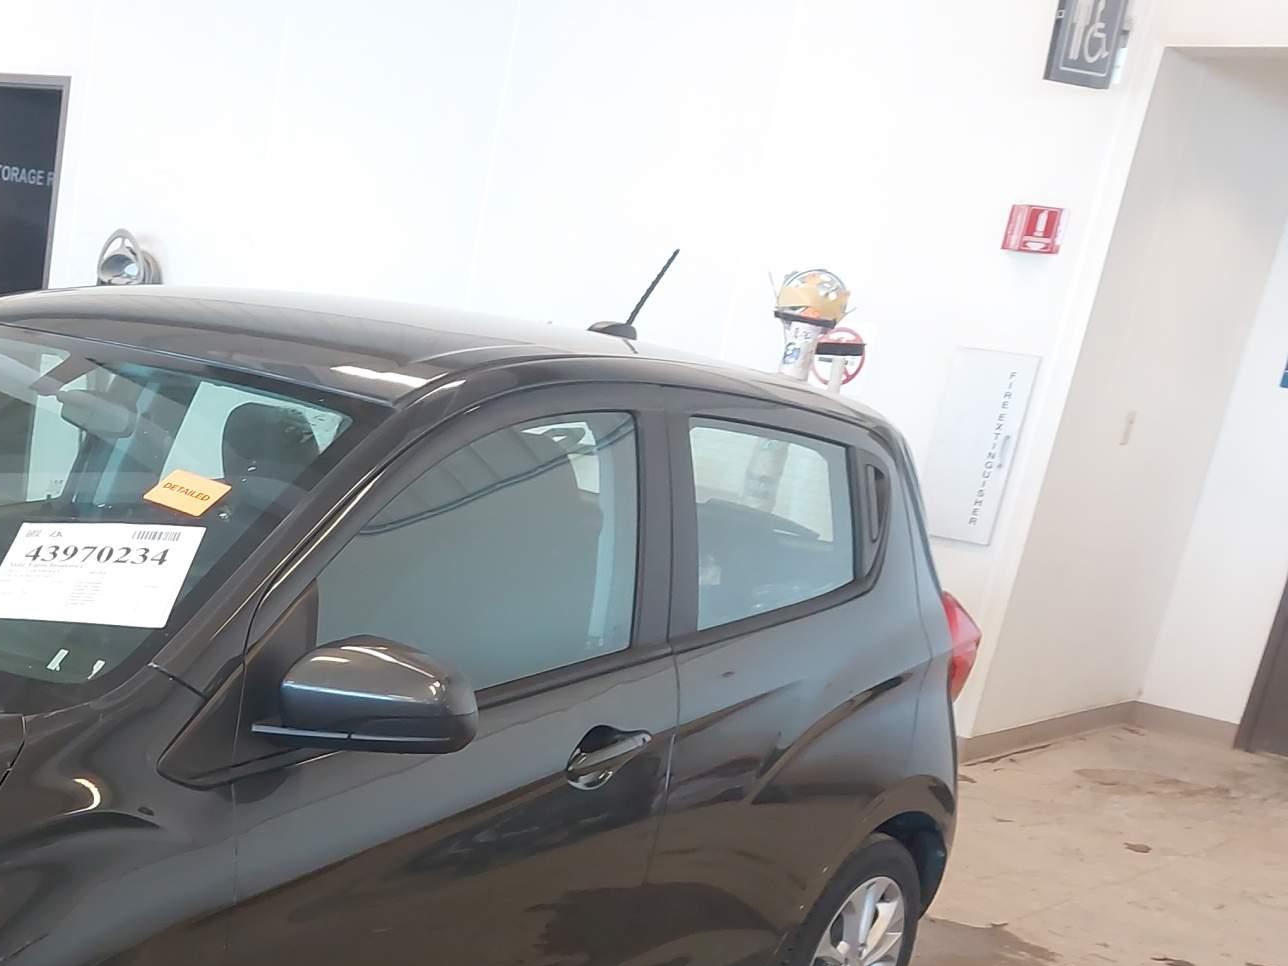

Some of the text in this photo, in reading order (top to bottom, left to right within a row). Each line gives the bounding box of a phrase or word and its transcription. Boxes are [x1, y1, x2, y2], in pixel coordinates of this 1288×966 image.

[968, 372, 1016, 526] FIRE EXTINGUISHER
[163, 482, 211, 501] DETAILED
[24, 544, 170, 566] 43970234
